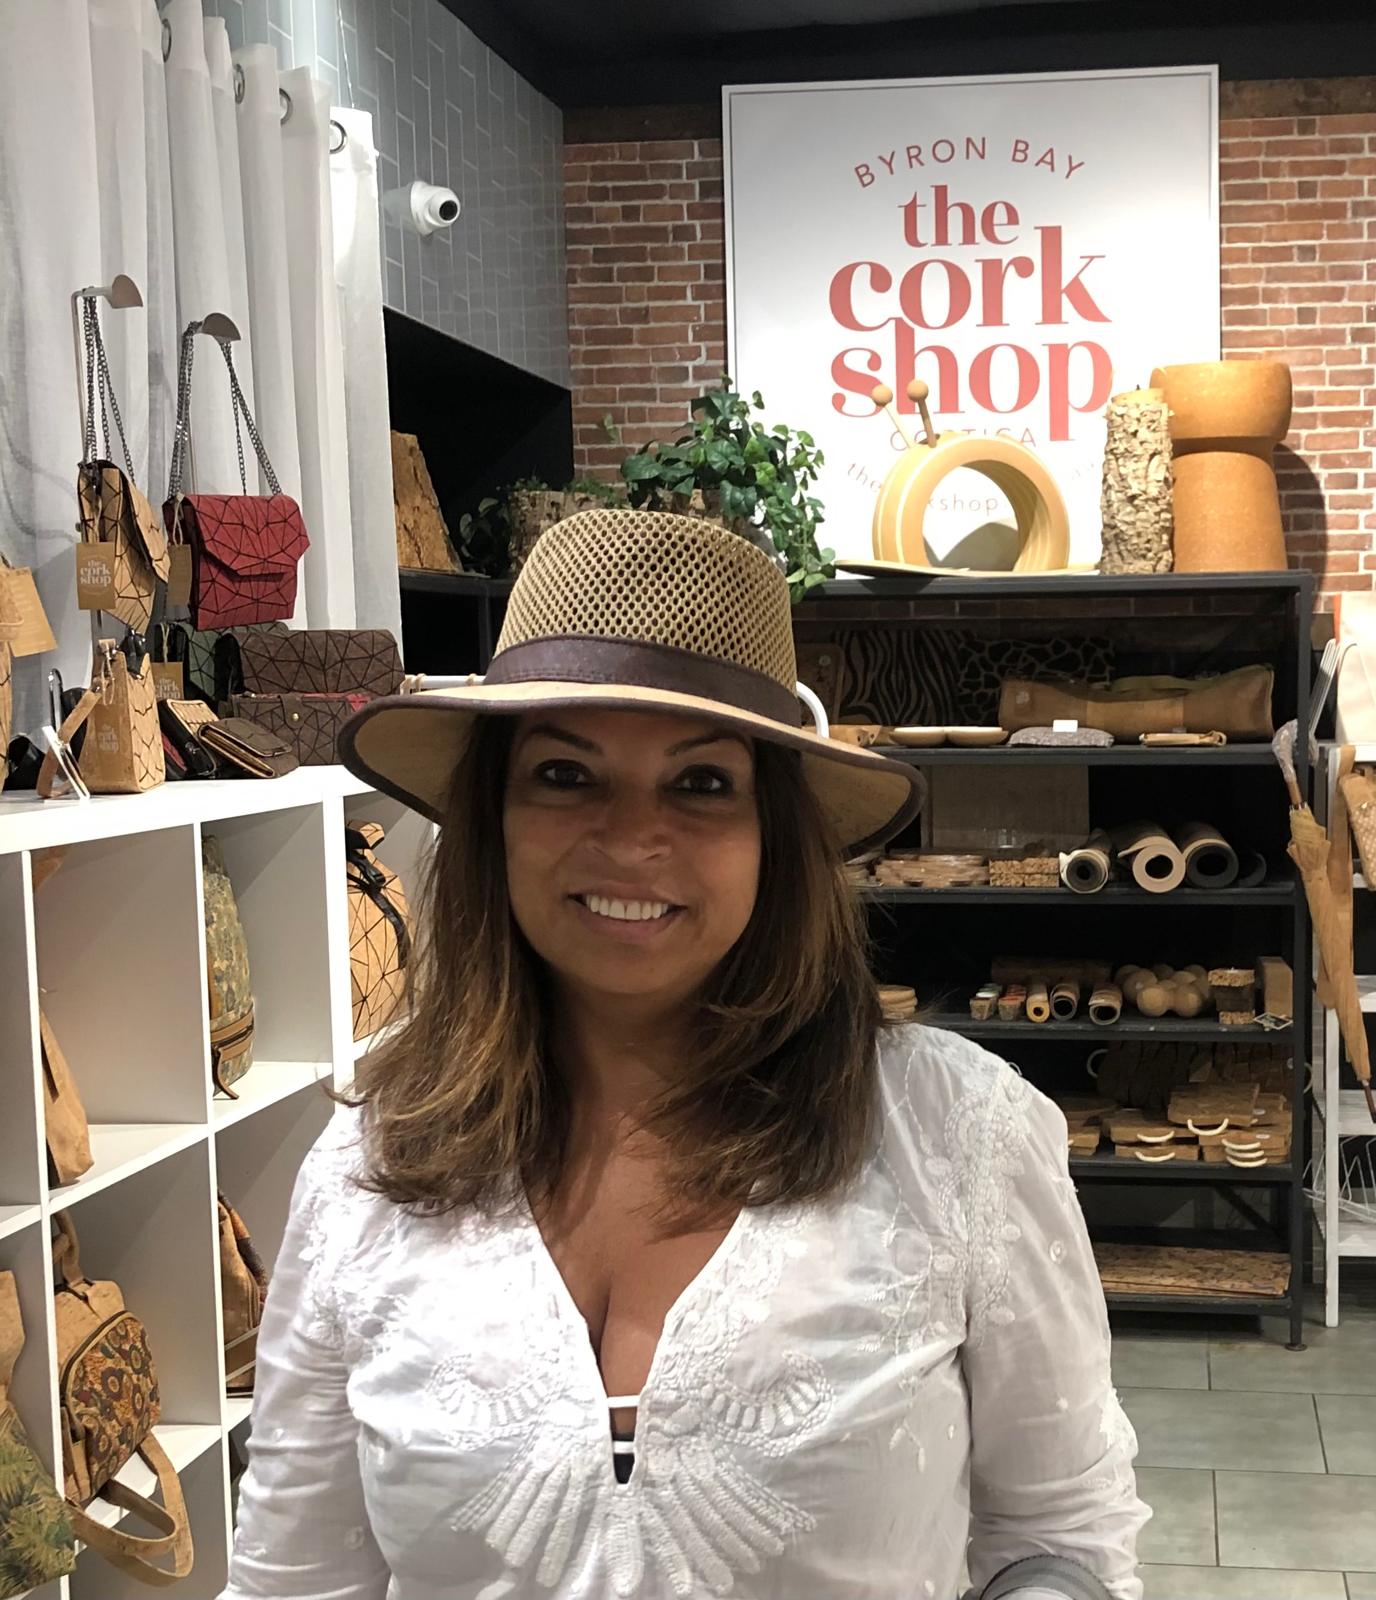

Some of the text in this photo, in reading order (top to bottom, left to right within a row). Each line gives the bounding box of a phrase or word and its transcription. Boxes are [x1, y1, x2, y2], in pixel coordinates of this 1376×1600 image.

[854, 136, 1085, 188] BYRON BAY
[897, 184, 1020, 248] the
[829, 225, 1113, 332] cork
[831, 317, 1114, 441] shop
